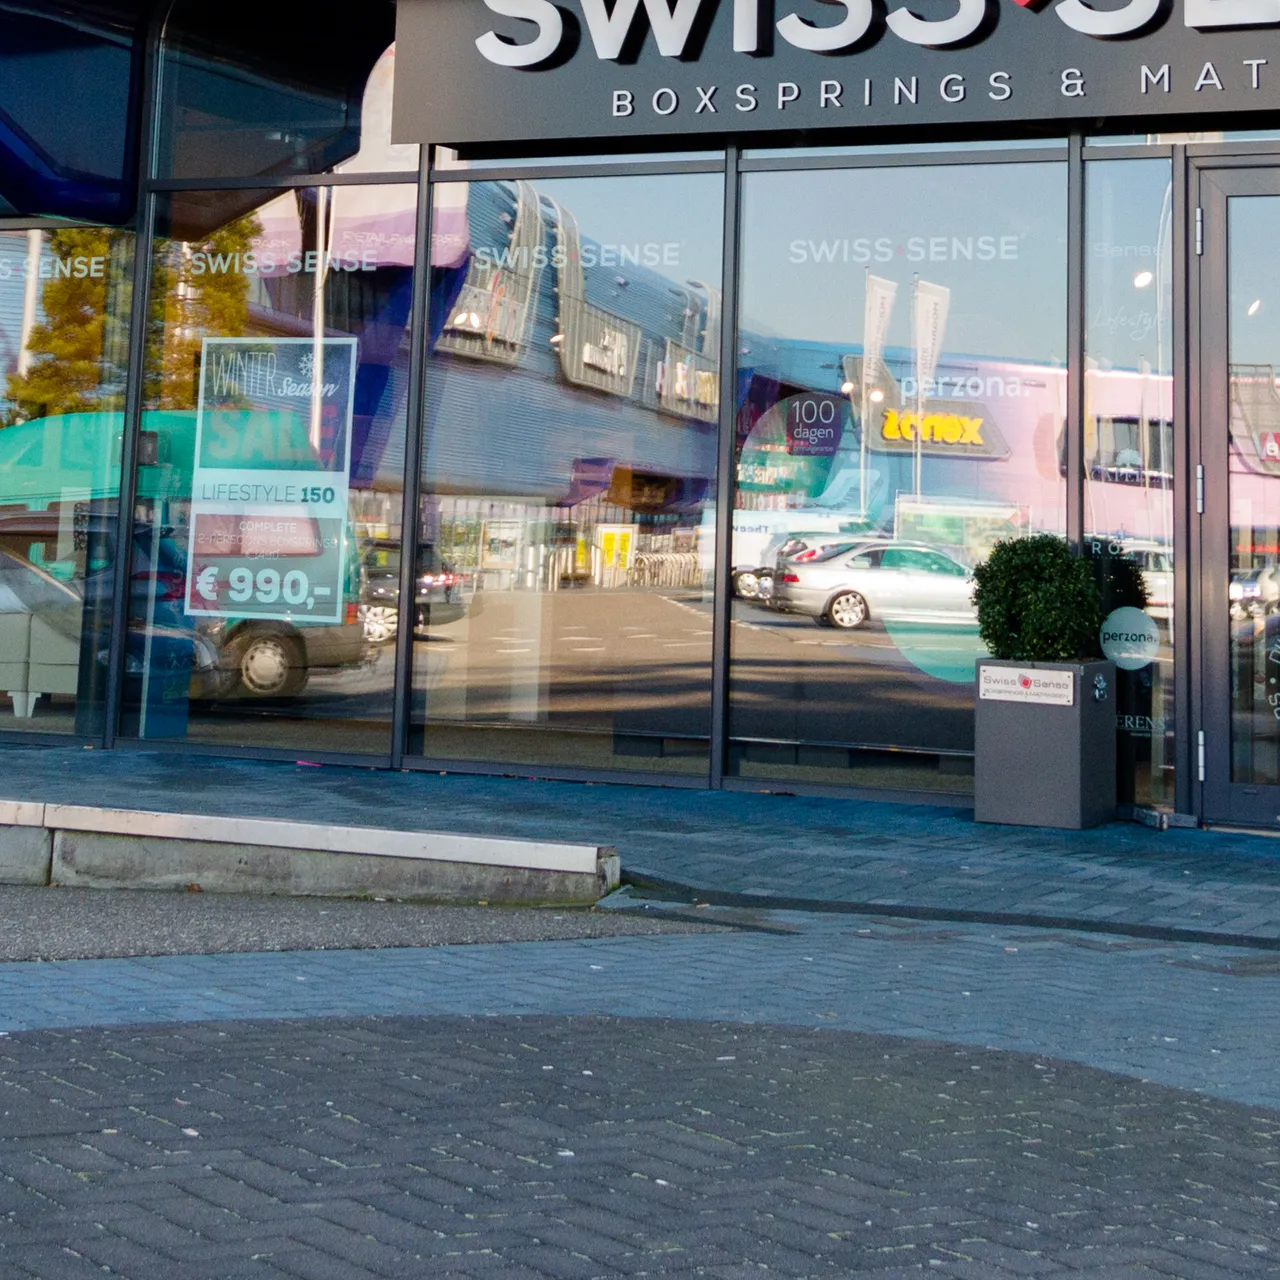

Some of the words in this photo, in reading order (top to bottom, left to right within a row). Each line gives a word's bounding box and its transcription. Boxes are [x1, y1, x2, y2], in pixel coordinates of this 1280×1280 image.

[610, 69, 1016, 120] BOXSPRINGS
[1059, 66, 1088, 98] &
[190, 251, 277, 274] SWISS
[286, 249, 379, 273] SENSE
[475, 245, 568, 270] SWISS
[580, 242, 681, 268] SENSE
[789, 239, 893, 264] SWISS
[905, 235, 1019, 261] SENSE
[20, 256, 106, 279] SENSE
[212, 352, 277, 396] WINTER
[901, 375, 1031, 405] perzona.
[791, 400, 835, 424] 100
[793, 422, 834, 444] dagen
[201, 484, 297, 503] LIFESTYLE
[301, 486, 335, 504] 150
[239, 521, 297, 533] COMPLETE
[196, 566, 219, 601] €
[228, 567, 332, 610] 990,-
[983, 675, 1017, 686] Swiss
